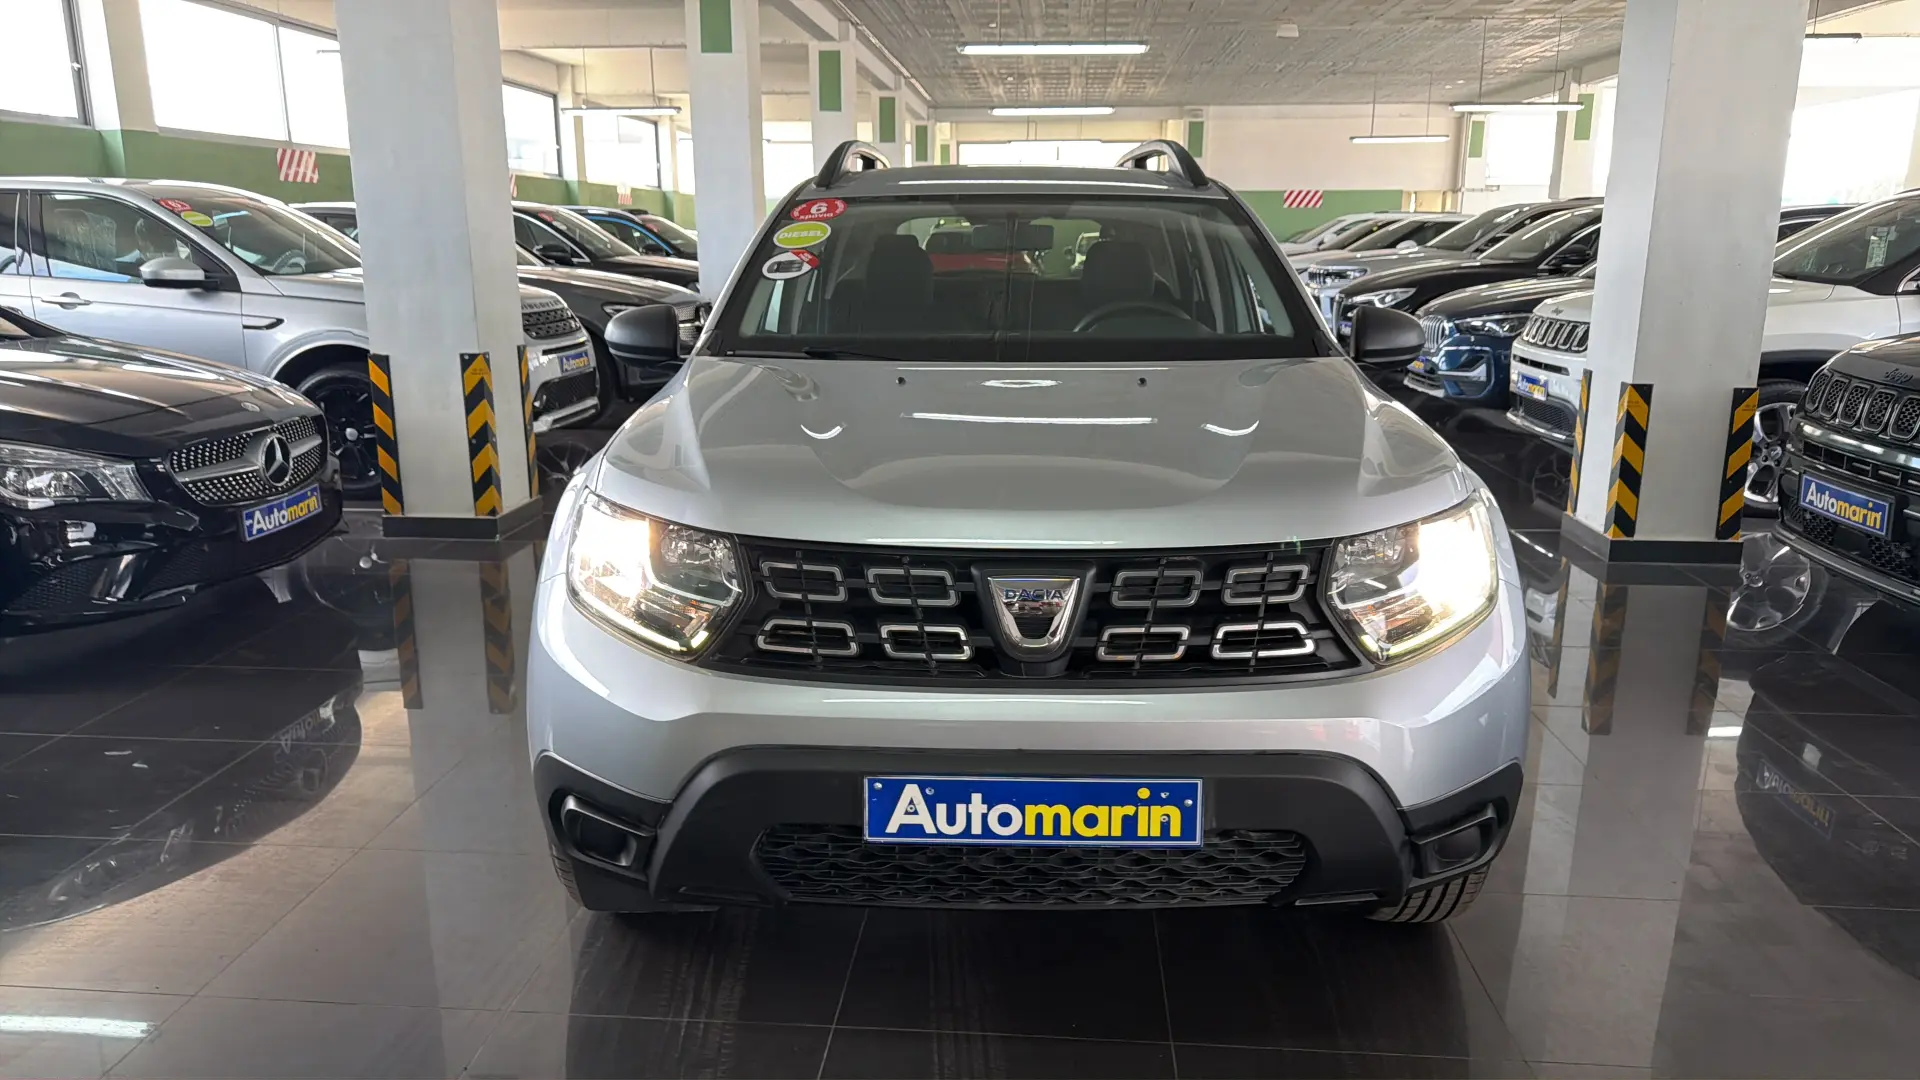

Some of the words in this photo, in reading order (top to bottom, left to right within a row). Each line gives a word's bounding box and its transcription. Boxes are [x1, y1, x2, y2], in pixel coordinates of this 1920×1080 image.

[810, 202, 828, 214] 6
[778, 230, 825, 240] DIESEL
[252, 491, 318, 535] Automarin
[1805, 482, 1882, 530] Automarin
[1004, 589, 1064, 601] DACIA
[884, 783, 1182, 838] Automarin
